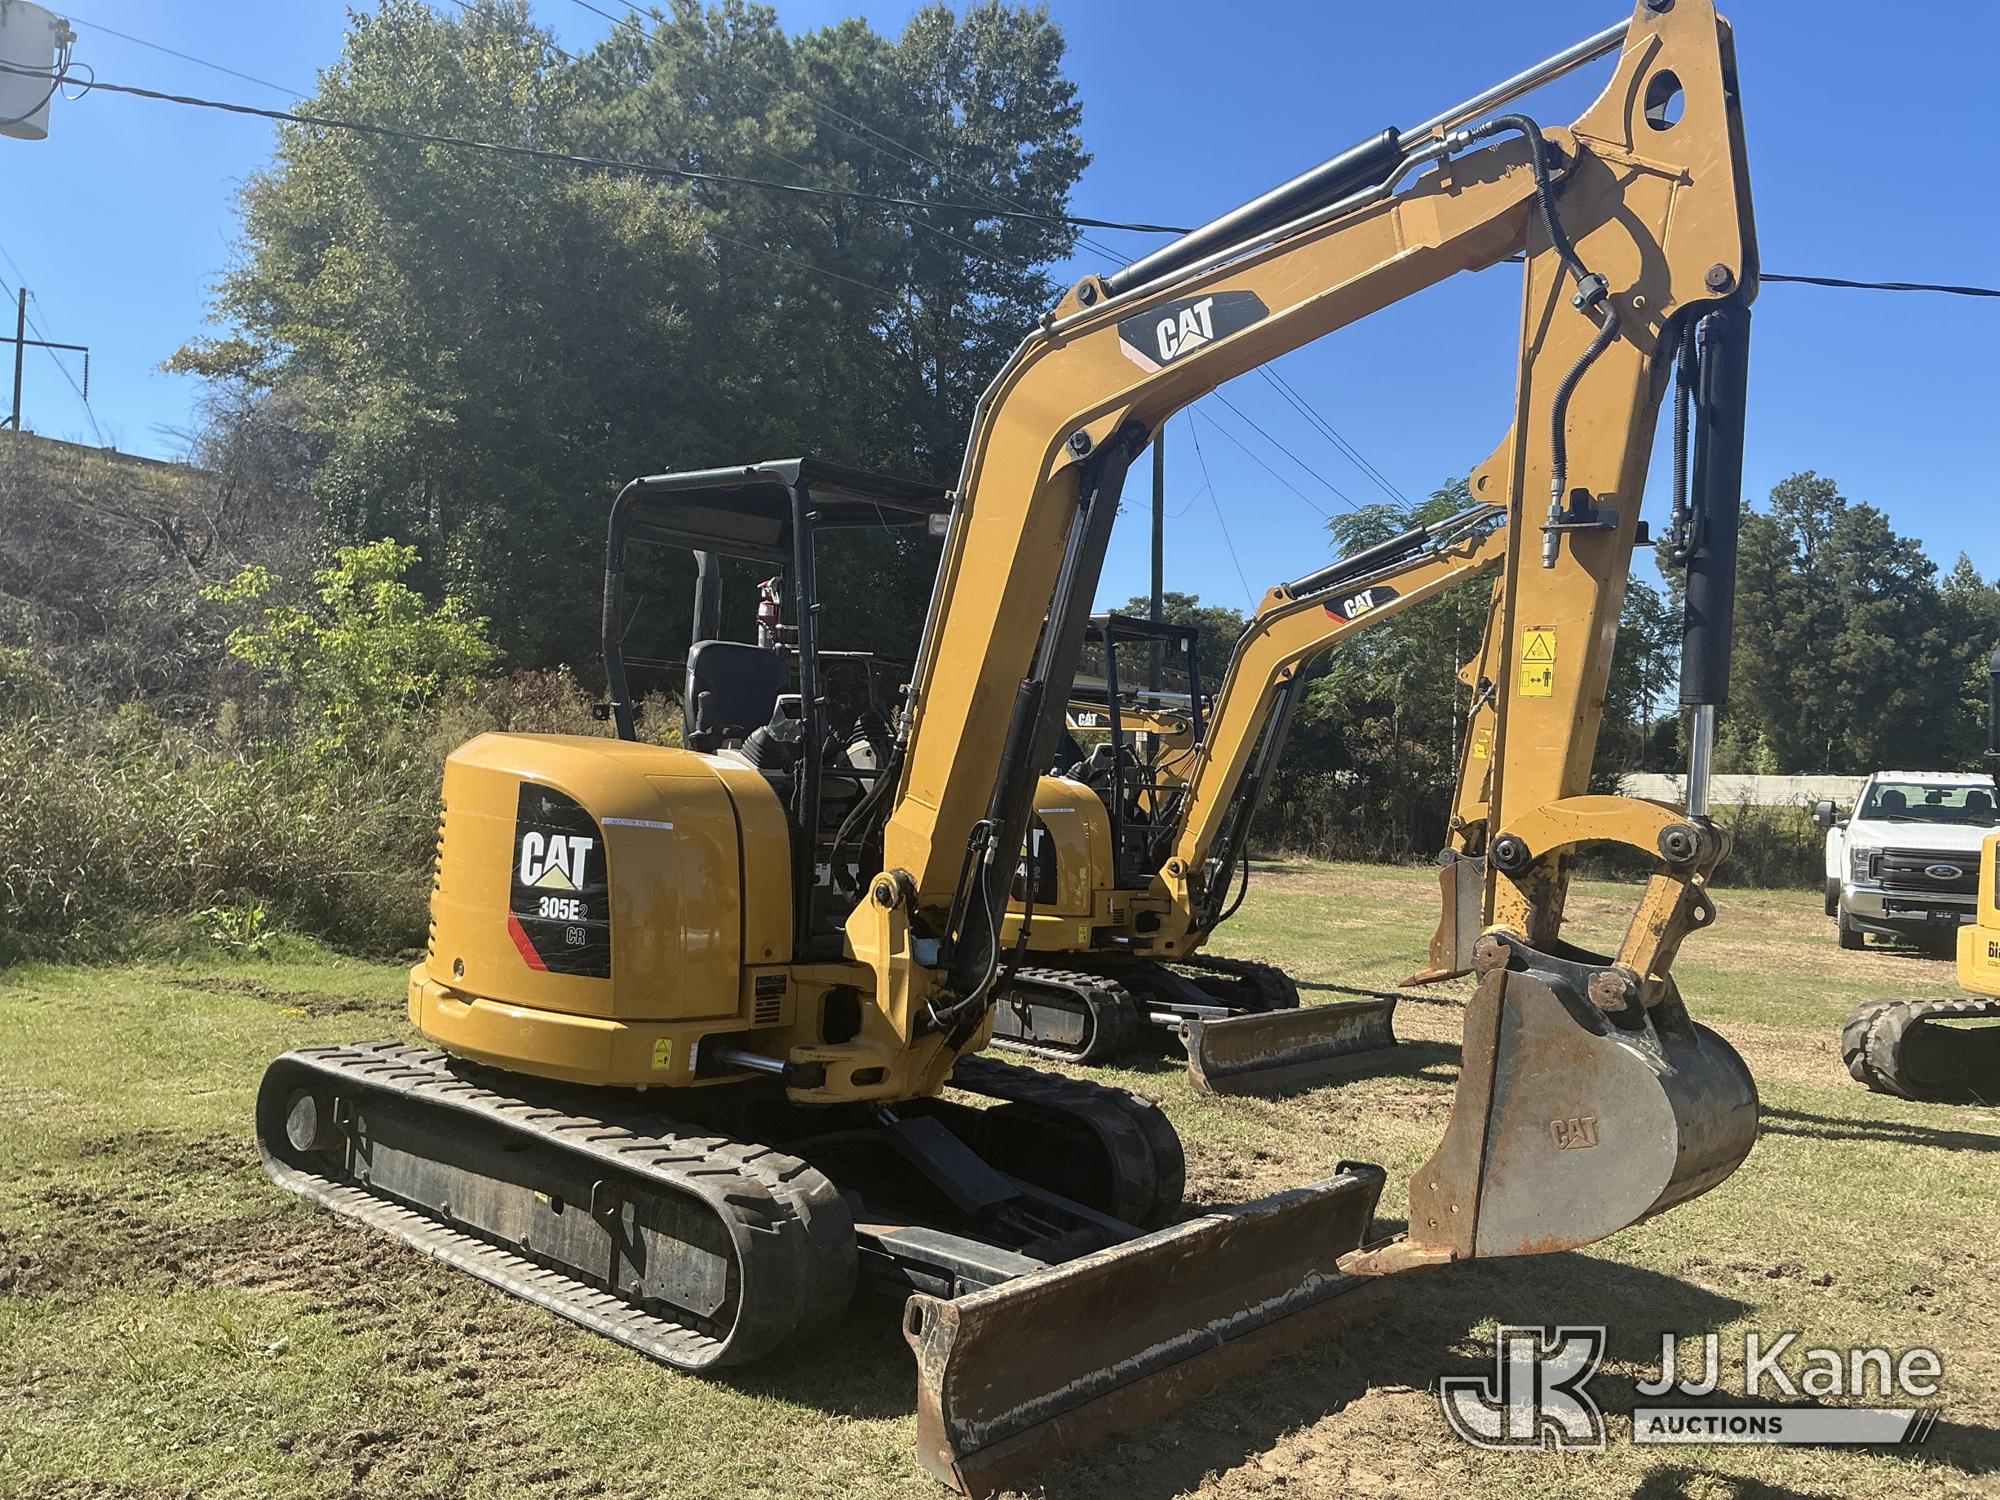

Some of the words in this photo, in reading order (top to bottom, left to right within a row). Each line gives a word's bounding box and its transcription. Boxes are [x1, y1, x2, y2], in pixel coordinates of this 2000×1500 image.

[1156, 297, 1214, 360] CAT
[1343, 589, 1375, 619] CAT
[1078, 713, 1098, 727] CAT
[520, 831, 593, 891] CAT
[538, 896, 588, 921] 305E2
[565, 927, 586, 945] CR
[1550, 1116, 1597, 1150] CAT
